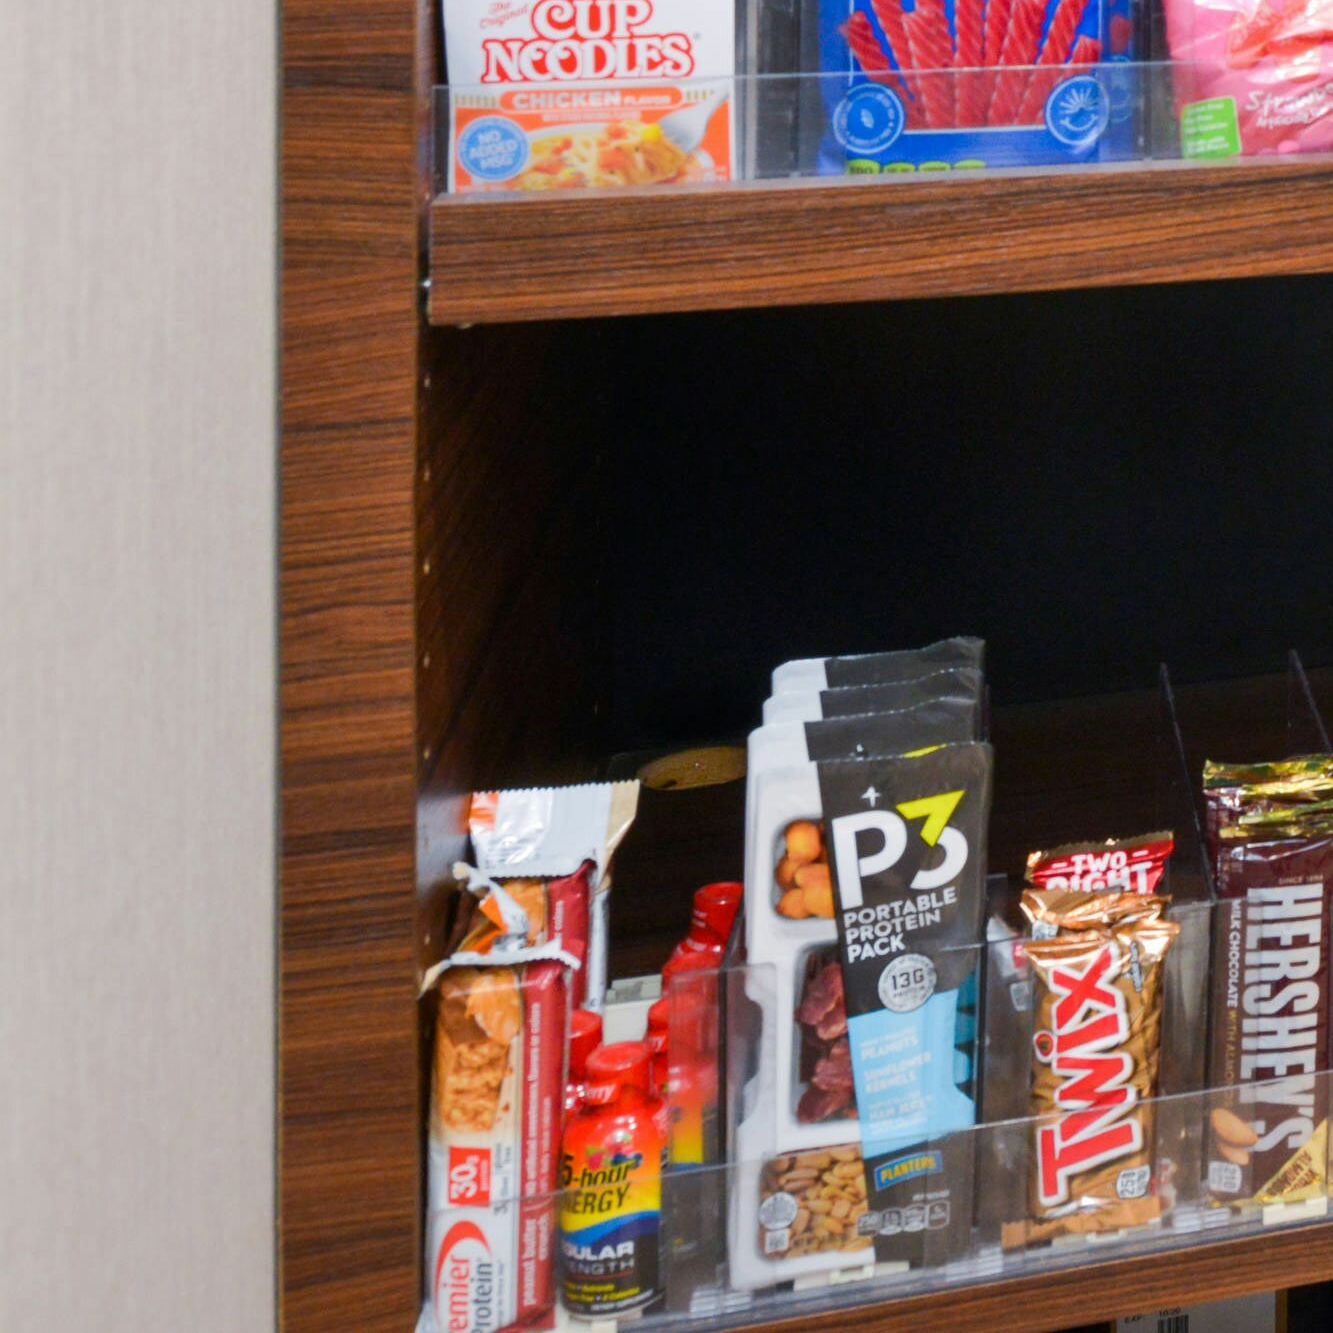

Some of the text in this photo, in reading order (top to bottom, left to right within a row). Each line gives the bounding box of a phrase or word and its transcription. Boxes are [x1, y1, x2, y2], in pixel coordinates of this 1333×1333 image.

[480, 33, 695, 83] NOODLES
[512, 91, 621, 109] CHICKEN
[832, 789, 970, 910] P3
[1071, 850, 1127, 877] TWO
[844, 886, 958, 926] PORTABLE
[846, 909, 941, 945] PROTEIN
[1229, 899, 1241, 928] MILK
[847, 932, 907, 964] PACK
[1226, 930, 1240, 1008] CHOCOLATE
[891, 967, 926, 992] 13G
[1240, 881, 1325, 1153] HERSHEY'S
[1033, 941, 1142, 1207] TWIX
[521, 1218, 538, 1307] peanut butter
[443, 1254, 471, 1332] emier
